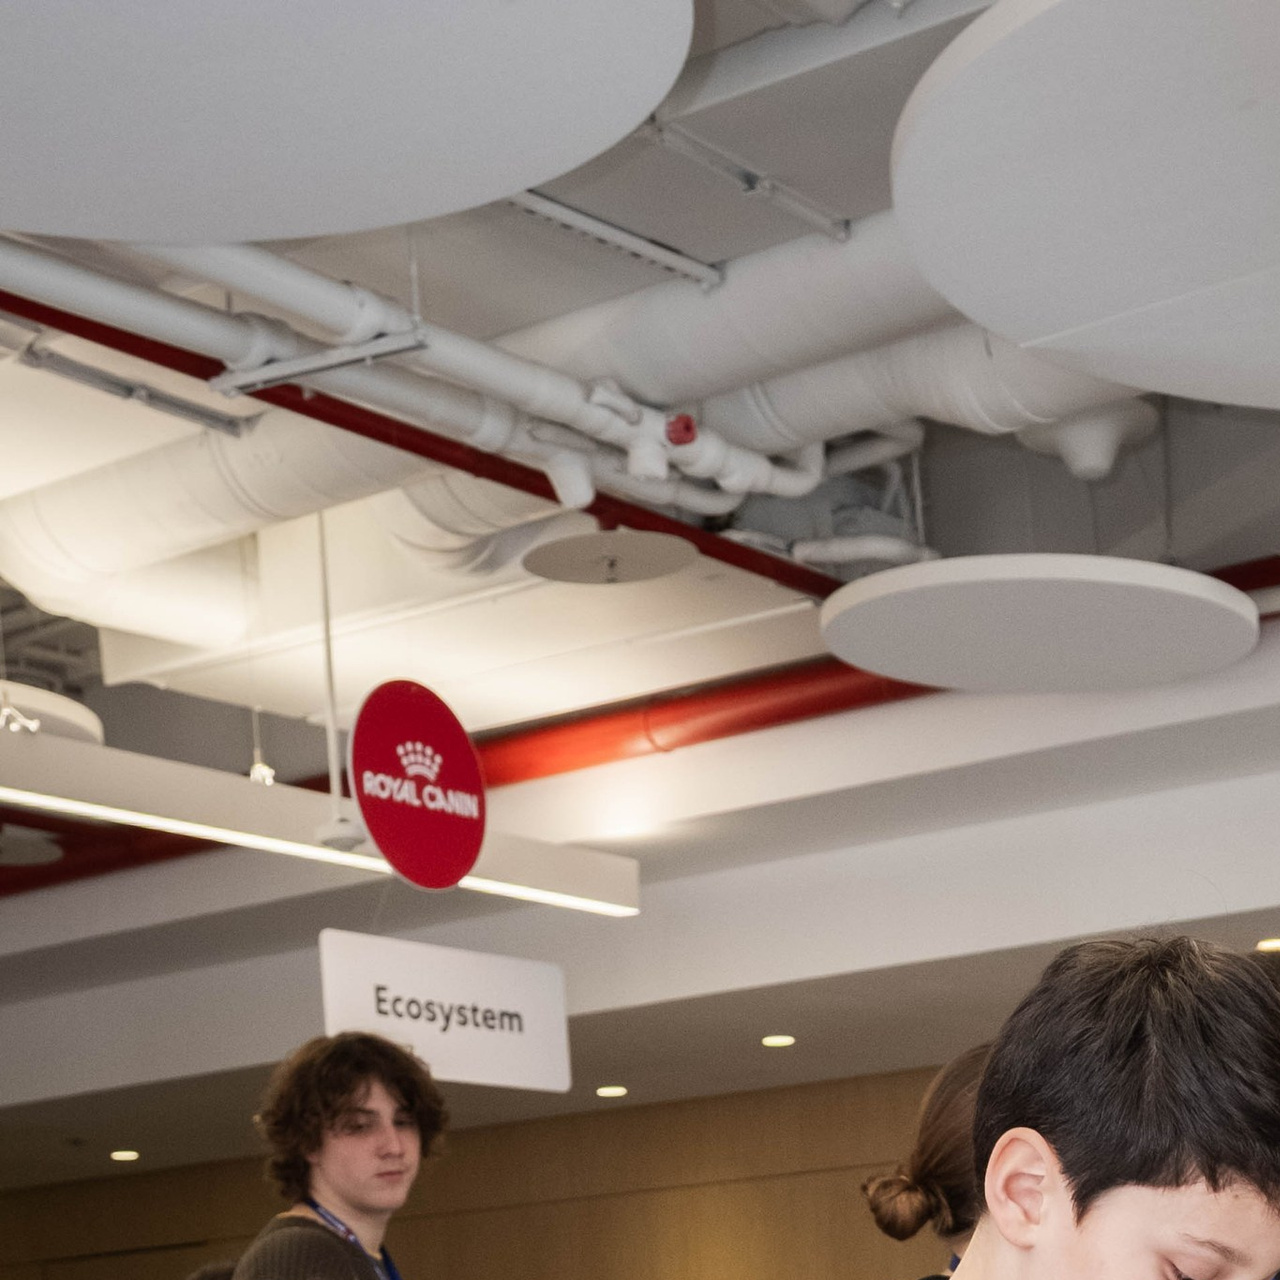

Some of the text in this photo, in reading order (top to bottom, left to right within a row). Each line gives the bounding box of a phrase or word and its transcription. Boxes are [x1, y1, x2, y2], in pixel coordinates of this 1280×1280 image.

[362, 770, 479, 819] ROYAL CANIN
[374, 984, 524, 1032] Ecosystem
